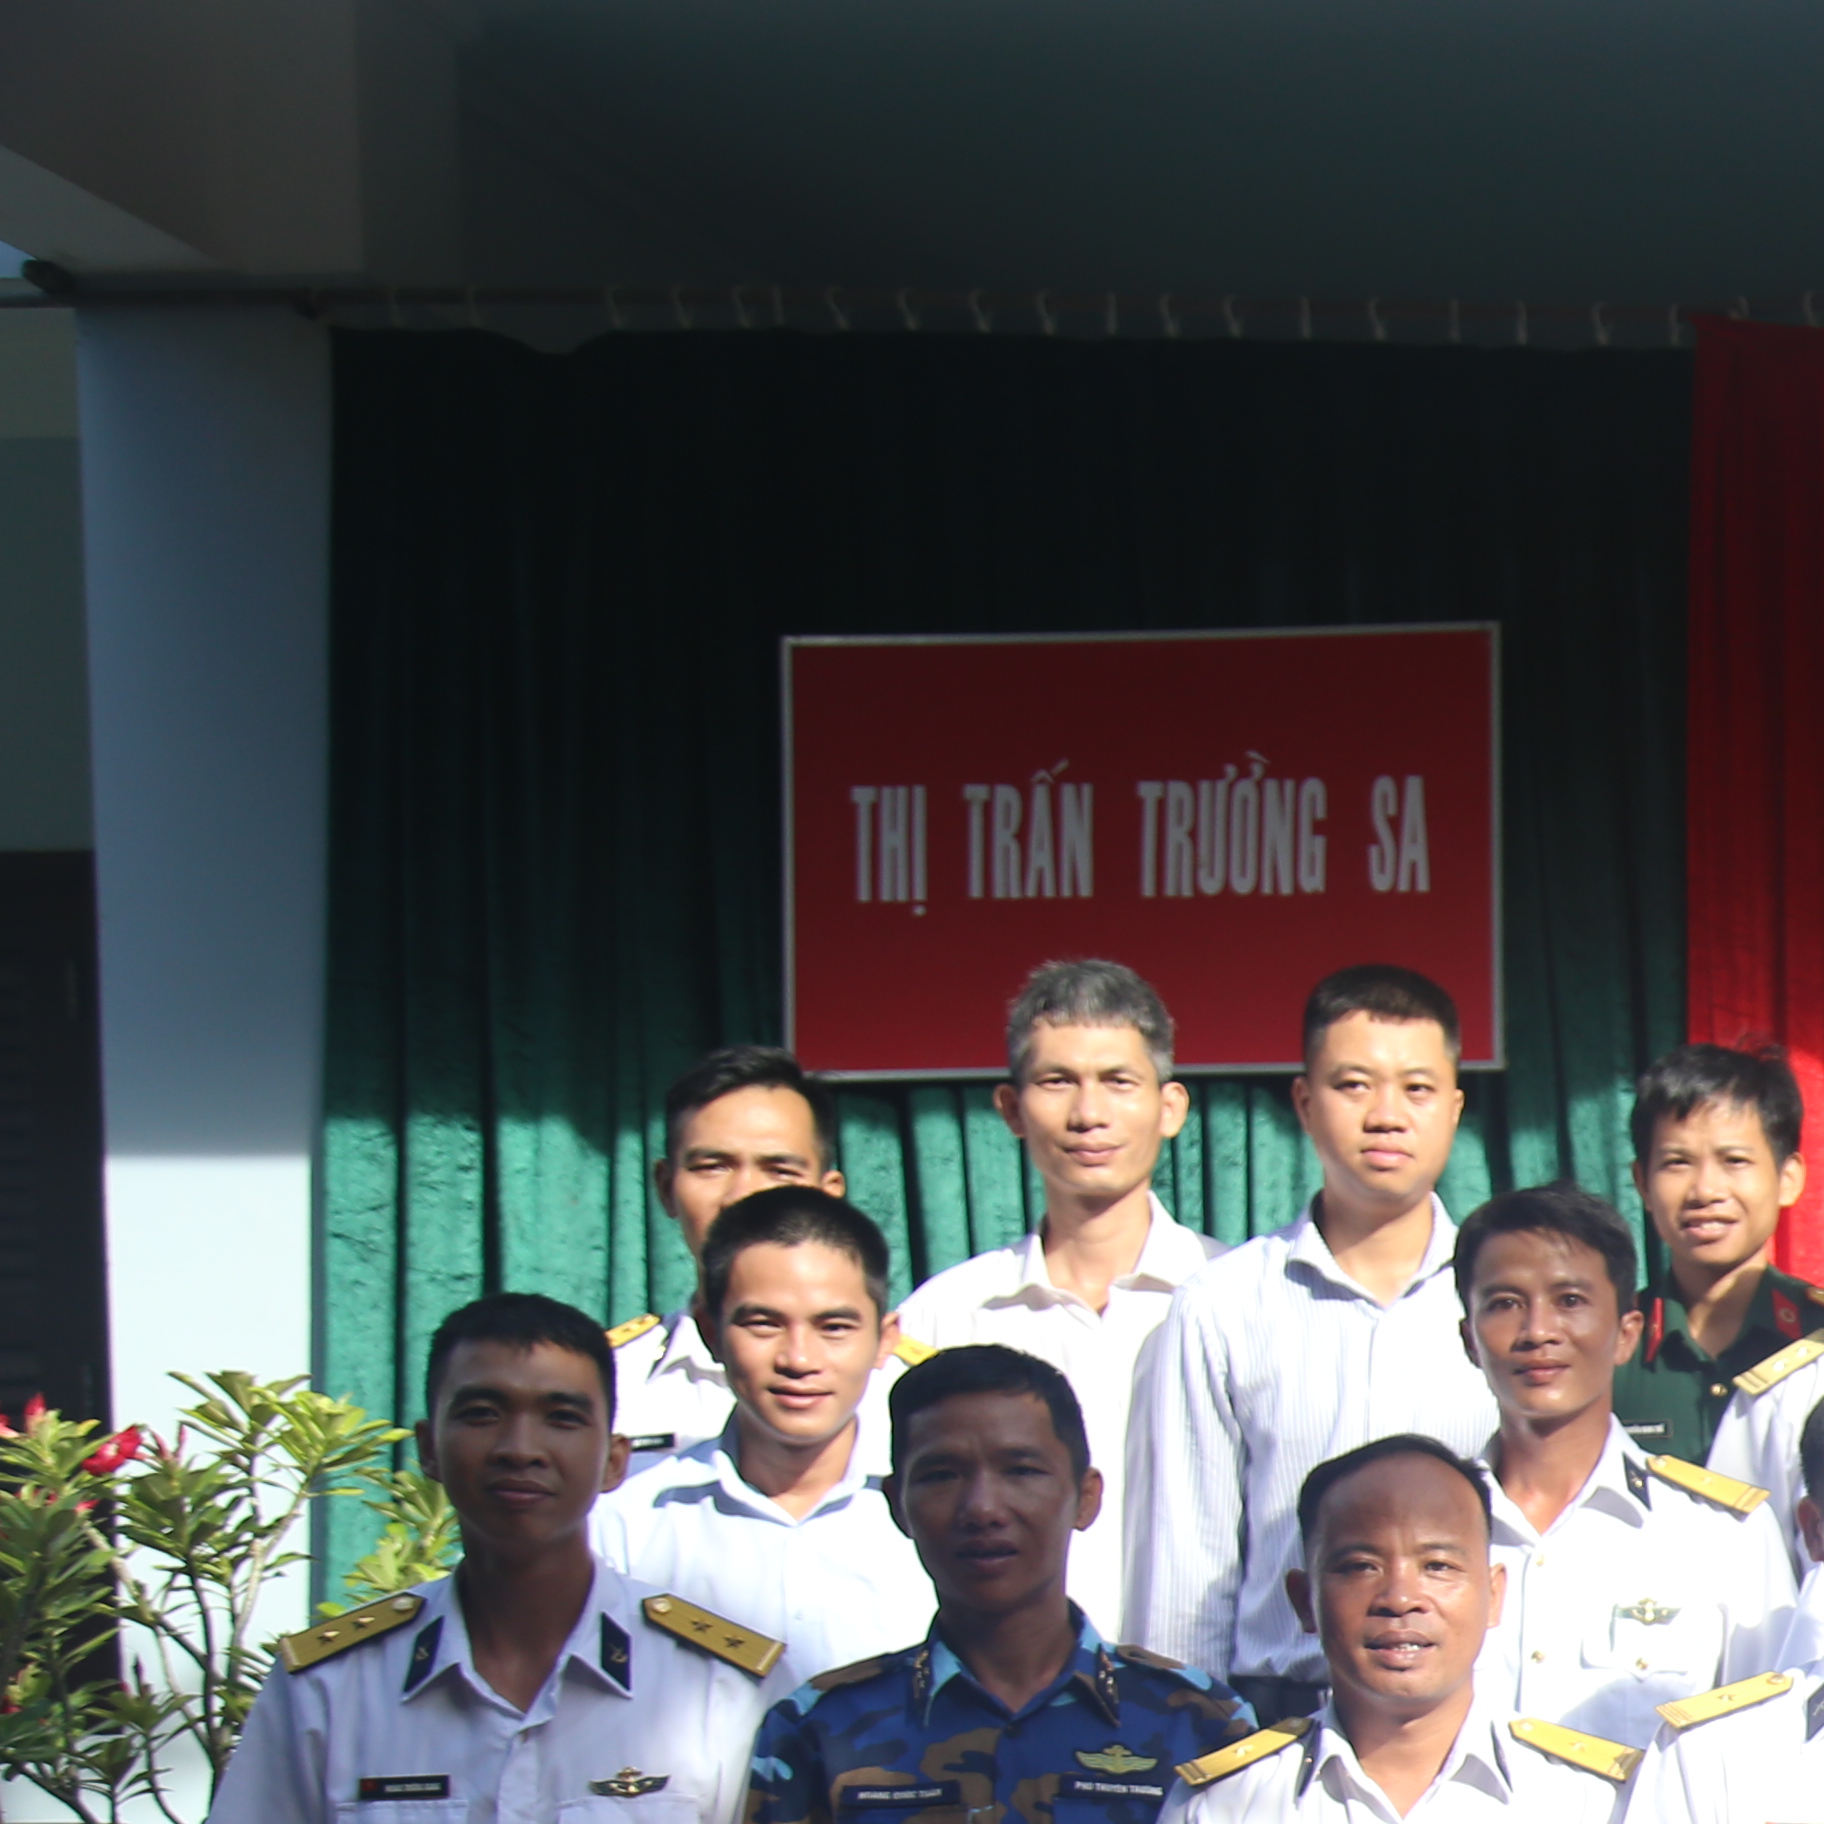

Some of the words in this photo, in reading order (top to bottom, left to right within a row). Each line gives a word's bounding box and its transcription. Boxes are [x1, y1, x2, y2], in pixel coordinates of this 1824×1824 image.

[850, 784, 928, 917] THỊ
[962, 758, 1094, 899] TRẤN
[1137, 750, 1328, 899] TRƯỜNG
[1367, 775, 1431, 894] SA
